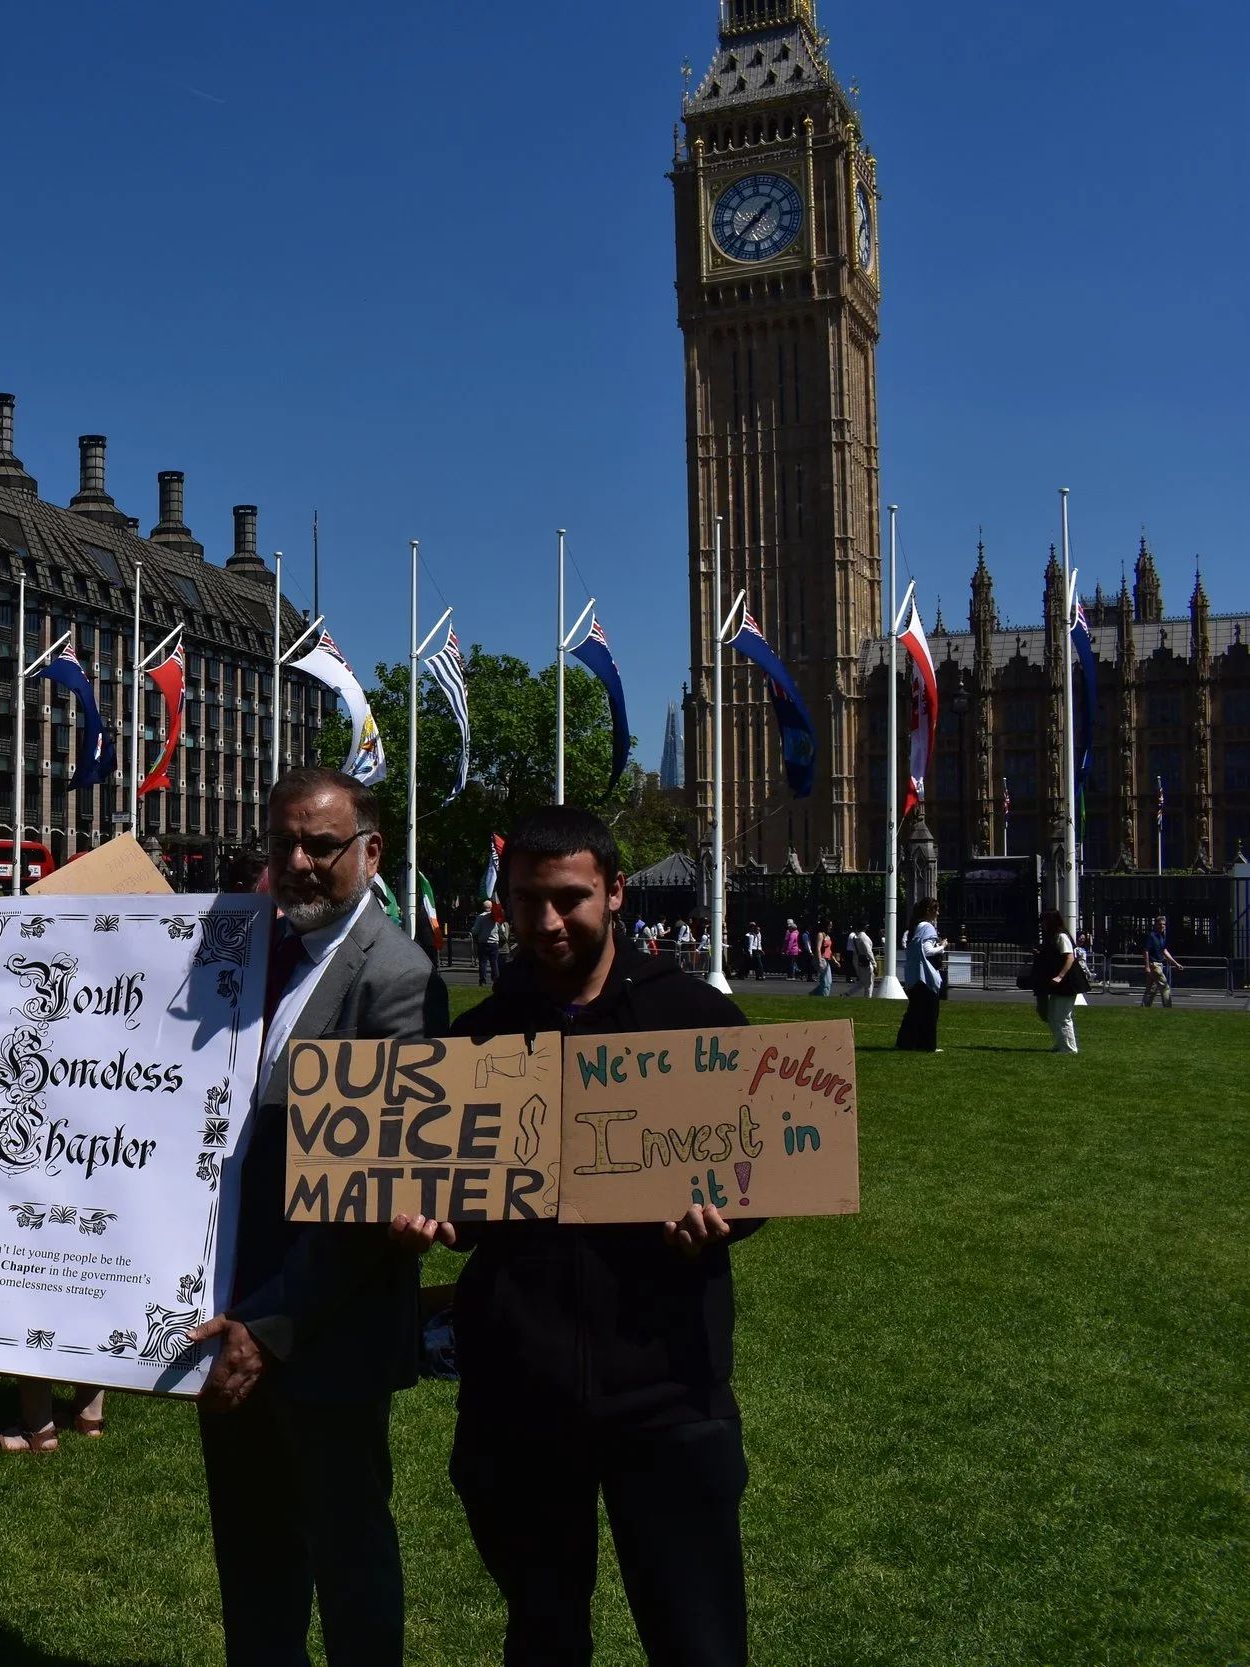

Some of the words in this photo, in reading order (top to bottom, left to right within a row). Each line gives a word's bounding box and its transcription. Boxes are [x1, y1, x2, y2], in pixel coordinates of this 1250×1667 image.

[3, 951, 146, 1030] Youth
[290, 1039, 447, 1105] OUR
[576, 1044, 672, 1089] We're
[695, 1036, 739, 1072] the
[574, 1105, 763, 1175] Invest
[782, 1111, 821, 1156] in
[691, 1161, 752, 1209] it!
[1, 1260, 46, 1274] Chapter
[49, 1265, 59, 1276] in
[62, 1267, 78, 1277] the
[80, 1271, 151, 1285] government's
[13, 1245, 25, 1256] let
[28, 1248, 60, 1262] young
[63, 1252, 97, 1267] people
[100, 1254, 112, 1265] be
[115, 1255, 131, 1266] the
[66, 1285, 107, 1299] strategy
